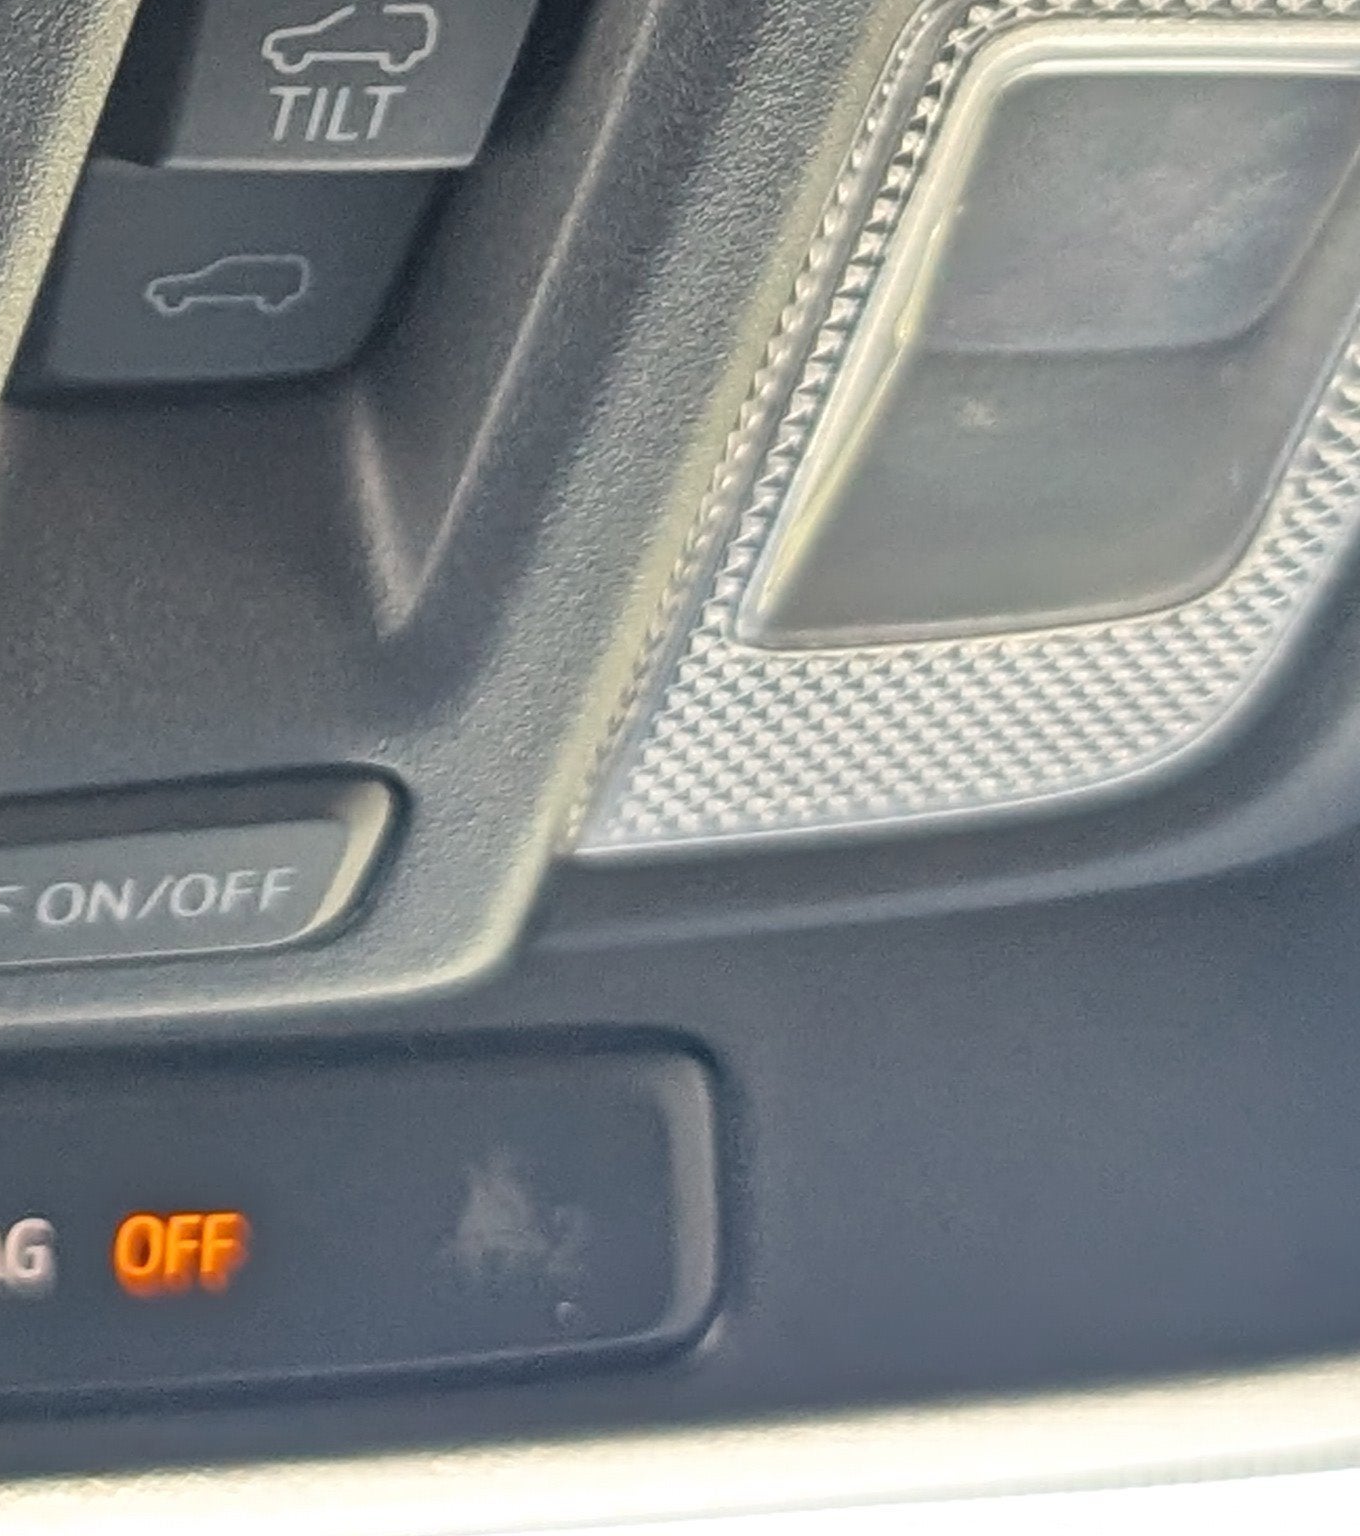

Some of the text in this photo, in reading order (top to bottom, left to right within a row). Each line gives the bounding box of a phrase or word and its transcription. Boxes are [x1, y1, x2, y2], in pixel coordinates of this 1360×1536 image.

[270, 86, 406, 141] TILT
[35, 867, 297, 926] ON/OFF
[113, 1211, 247, 1294] OFF
